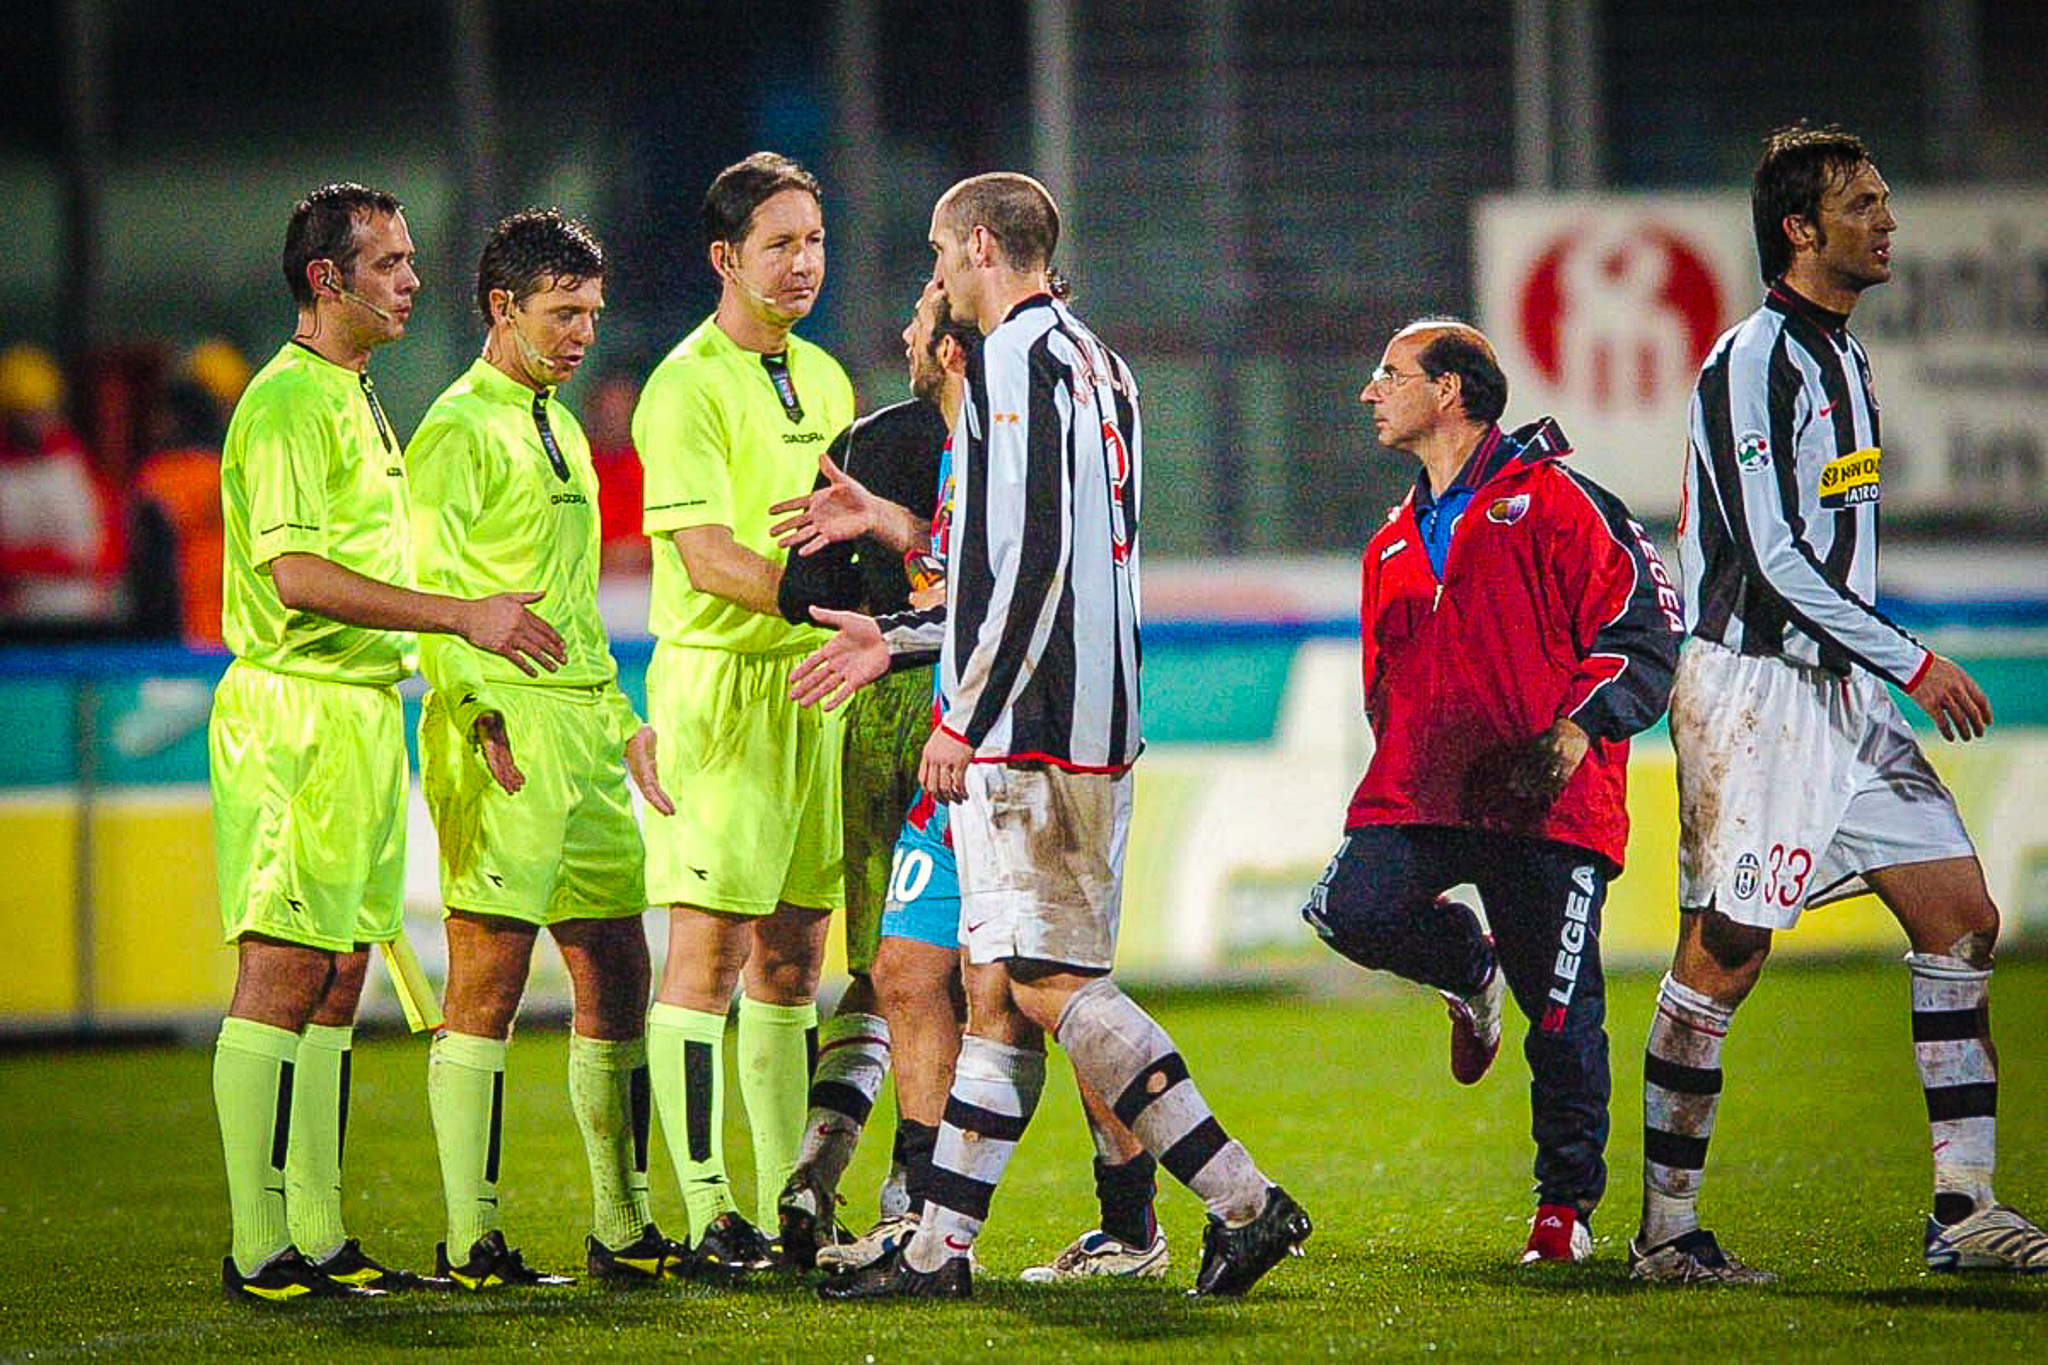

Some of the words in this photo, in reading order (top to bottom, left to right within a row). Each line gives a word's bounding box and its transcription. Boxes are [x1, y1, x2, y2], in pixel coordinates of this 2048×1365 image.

[1626, 518, 1685, 632] LEGEA
[886, 848, 933, 902] 10
[1764, 844, 1812, 907] 33
[1549, 866, 1595, 1006] LEGEA
